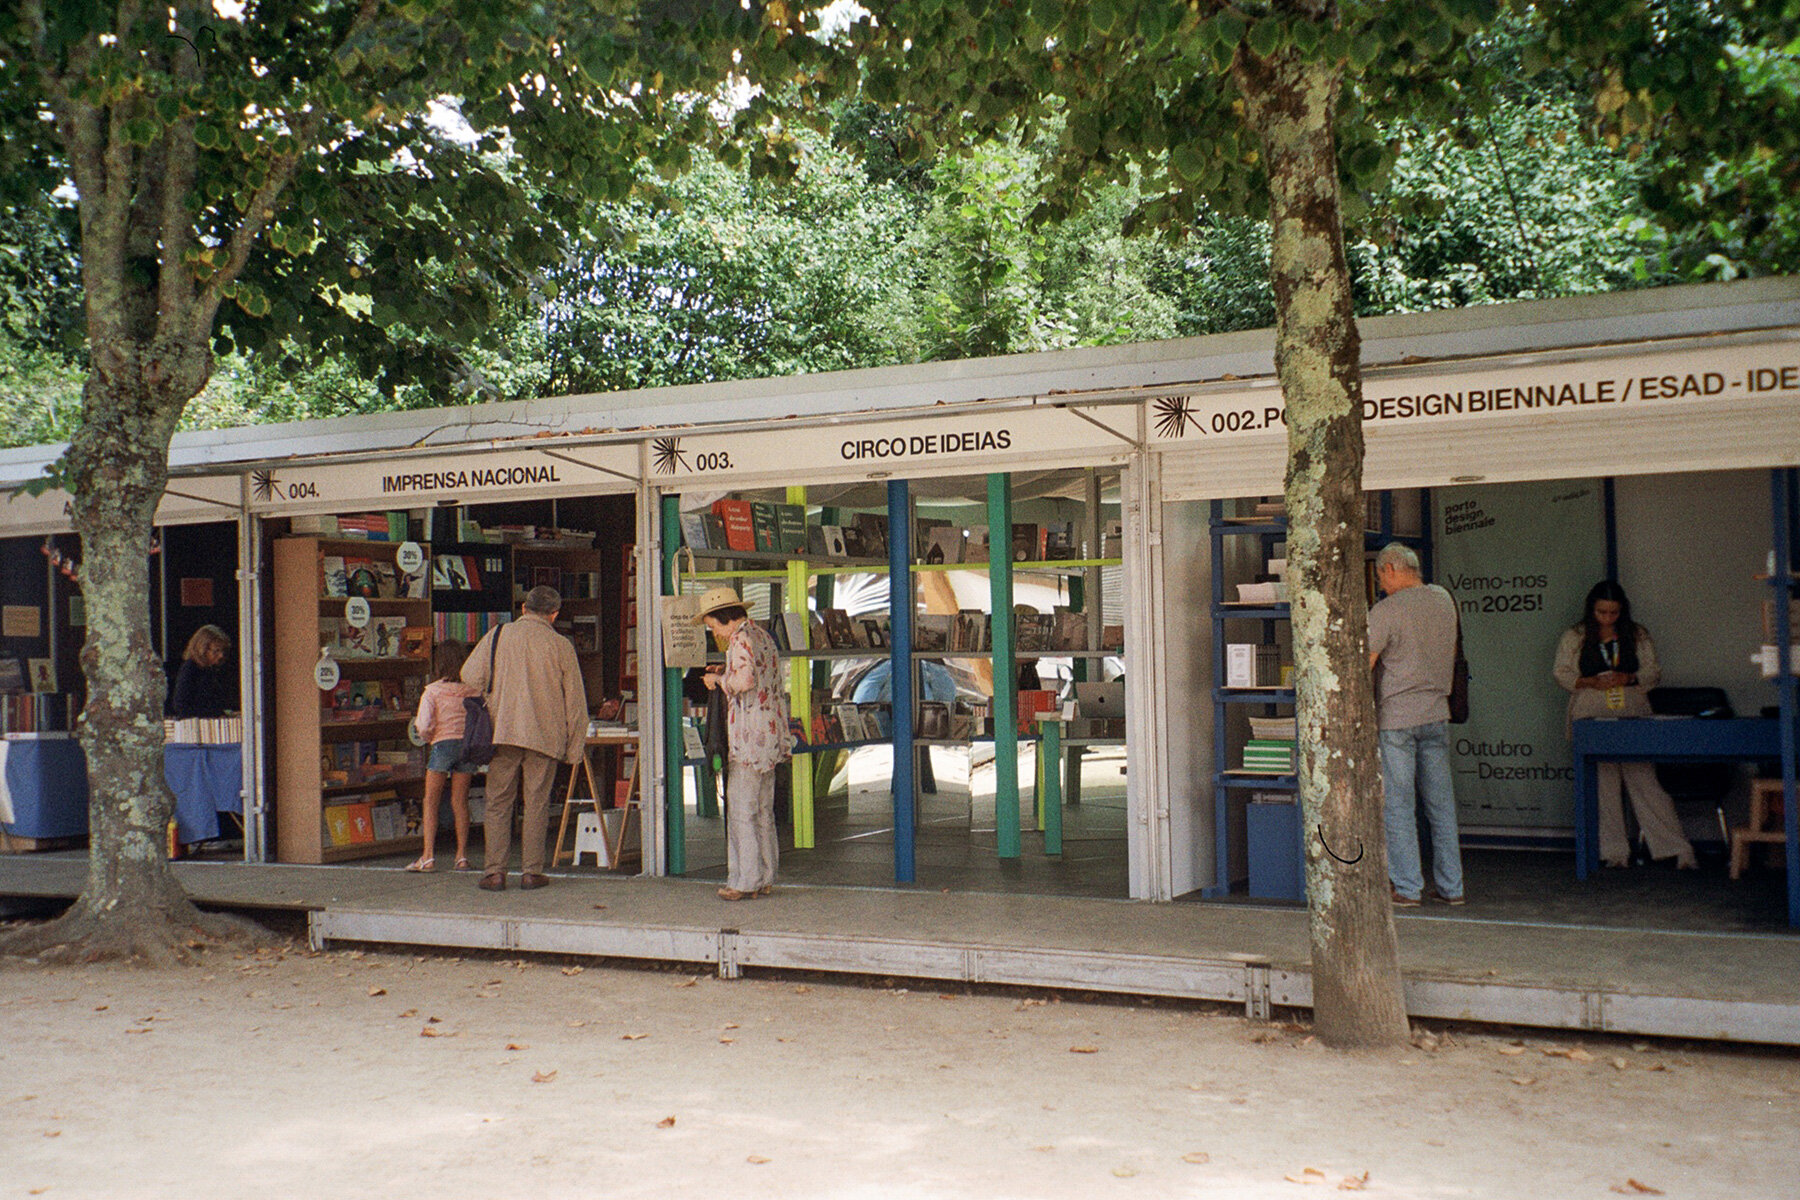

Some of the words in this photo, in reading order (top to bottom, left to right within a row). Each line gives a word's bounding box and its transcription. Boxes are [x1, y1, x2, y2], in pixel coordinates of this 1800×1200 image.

[1211, 407, 1288, 433] 002.P
[1362, 392, 1463, 421] DESIGN
[1468, 380, 1616, 413] BIENNALE
[1621, 378, 1634, 402] /
[1640, 372, 1725, 401] ESAD
[1747, 366, 1799, 393] IDE
[696, 451, 734, 471] 003.
[841, 437, 907, 460] CIRCO
[910, 435, 938, 455] DE
[940, 429, 1012, 454] IDEIAS
[289, 481, 320, 499] 004.
[382, 470, 469, 493] IMPRENSA
[471, 465, 561, 487] NACIONAL
[1444, 500, 1477, 515] porto
[1444, 508, 1484, 525] design
[1445, 516, 1496, 535] biennale
[1447, 573, 1548, 591] Vemo-nos
[1461, 600, 1479, 613] m
[1482, 594, 1543, 613] 2025!
[1456, 738, 1533, 757] Outubro
